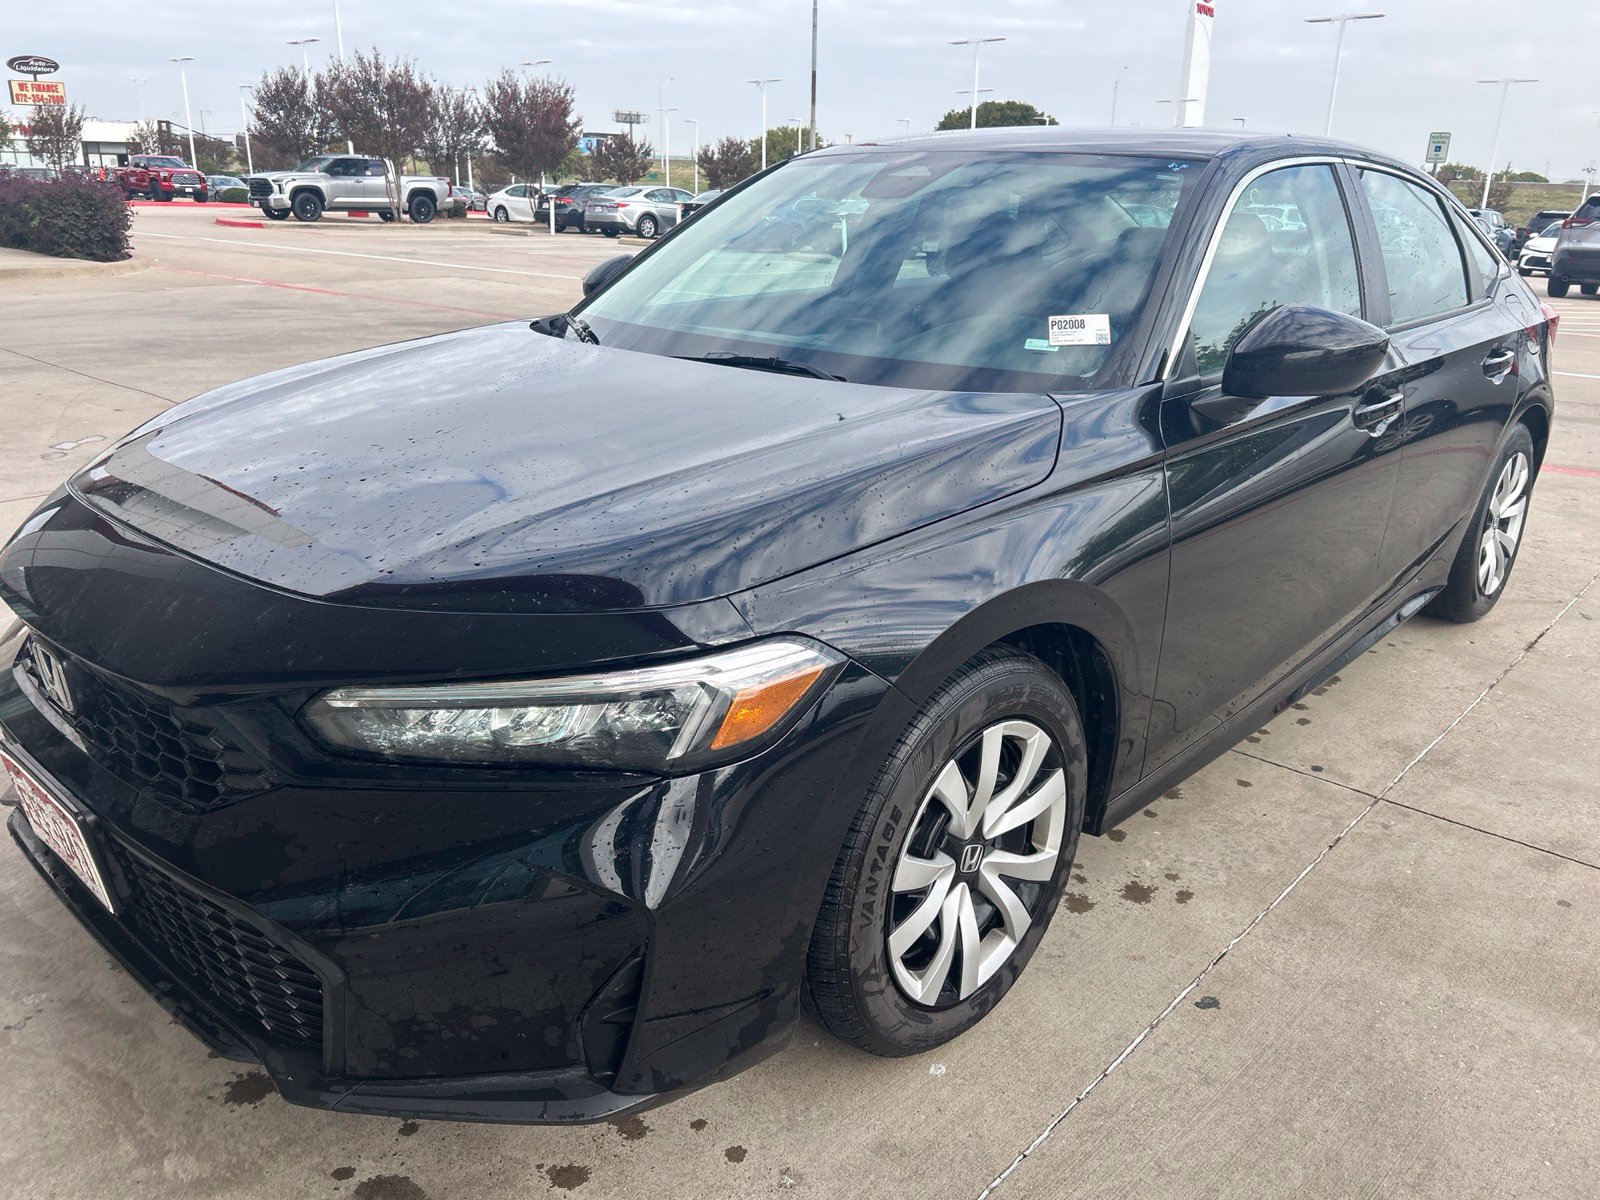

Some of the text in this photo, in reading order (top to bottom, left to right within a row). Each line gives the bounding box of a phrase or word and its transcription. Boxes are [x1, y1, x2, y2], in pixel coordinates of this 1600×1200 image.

[15, 64, 55, 72] Liquidators
[18, 83, 59, 93] WE FINANCE
[1051, 319, 1085, 330] P02008
